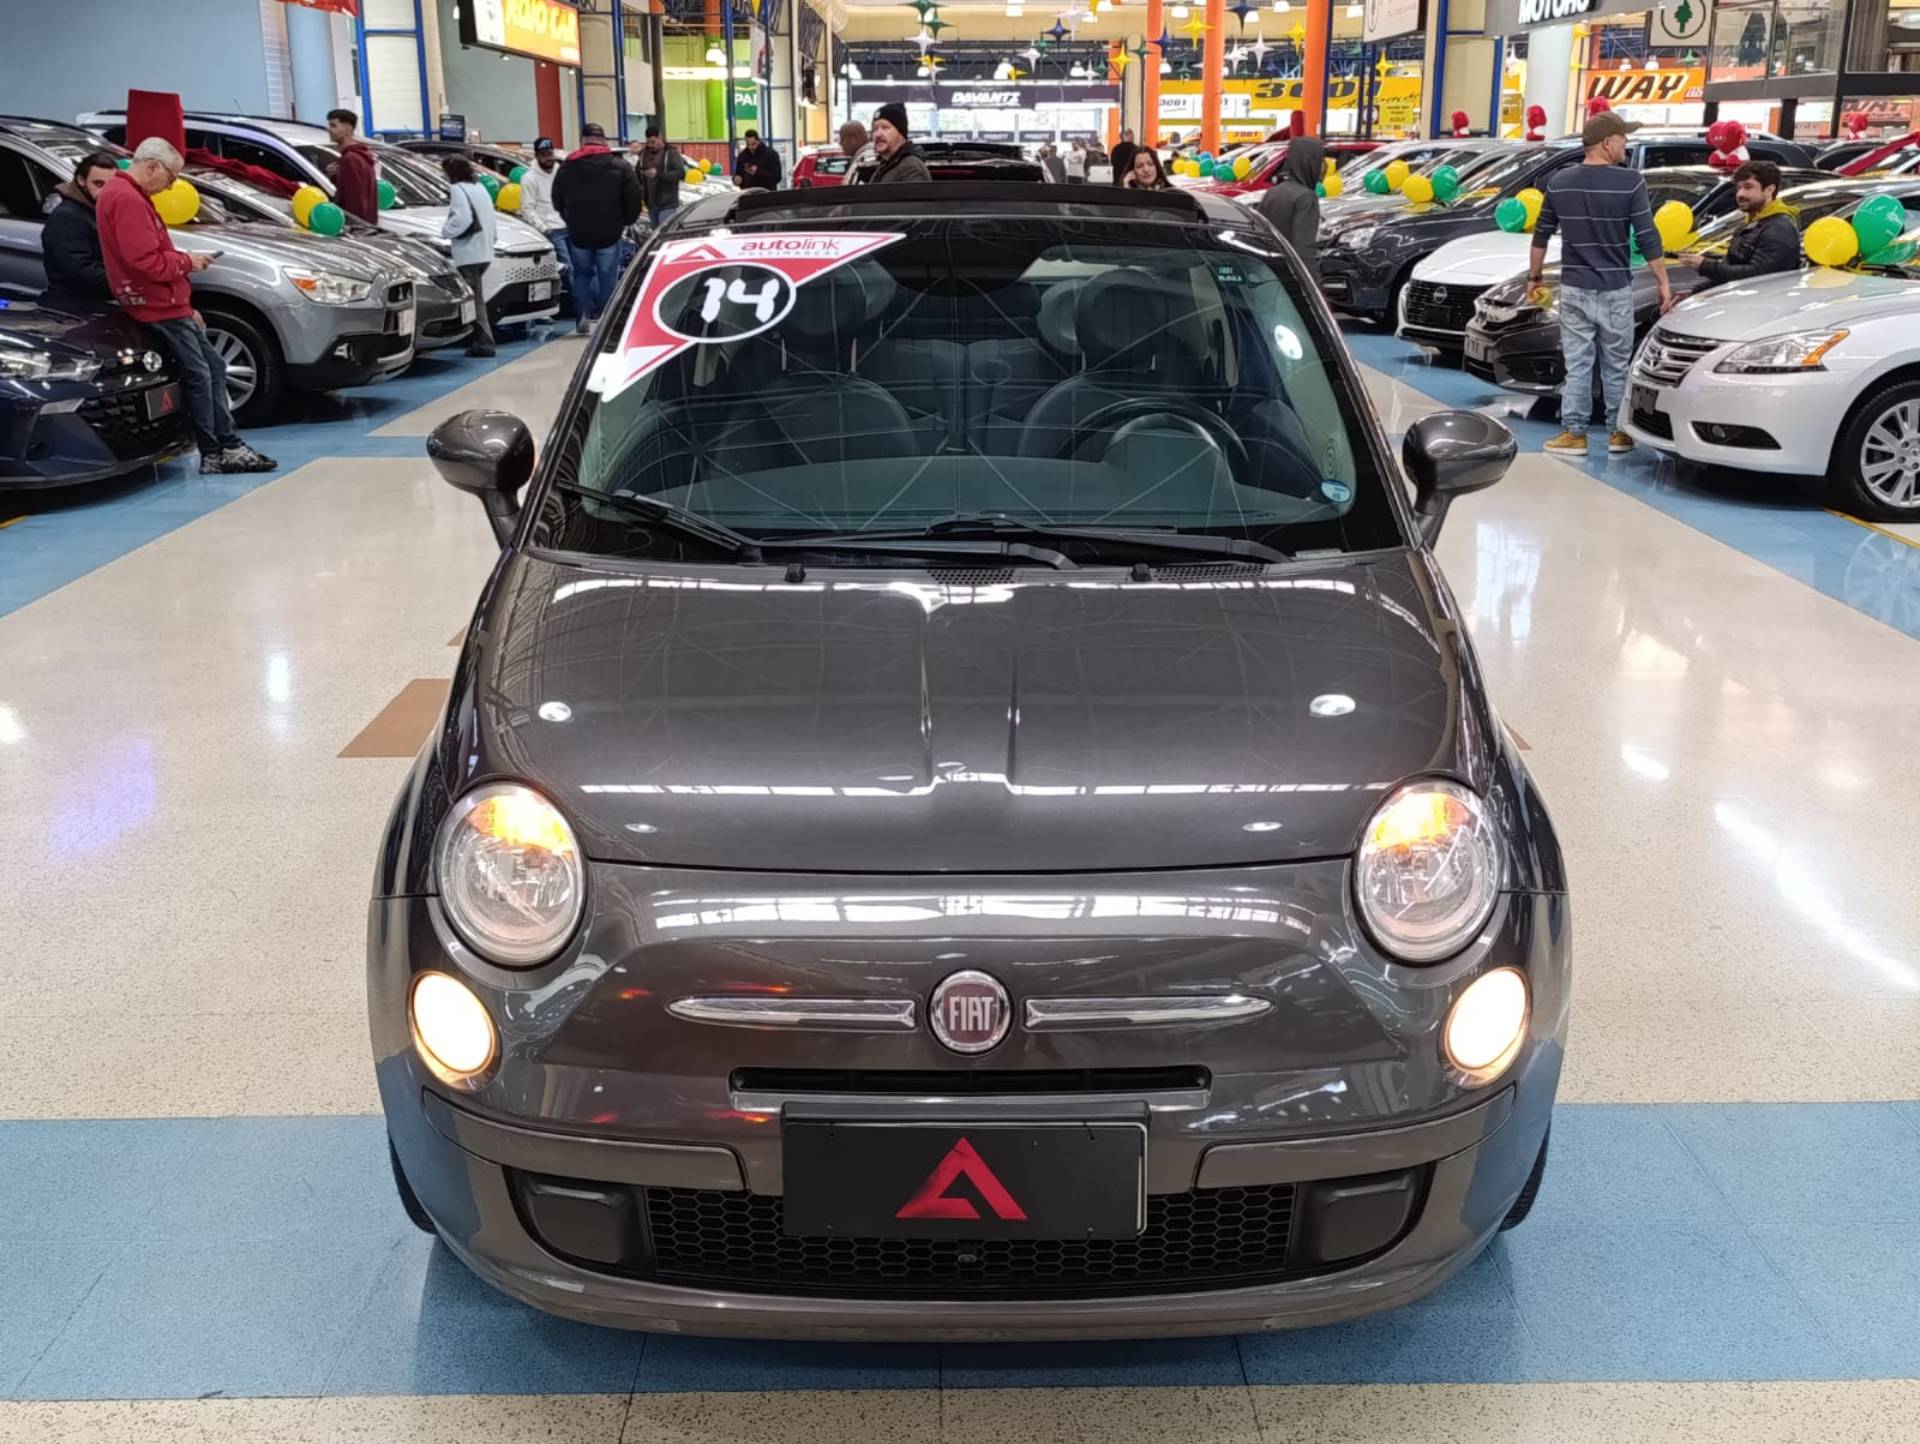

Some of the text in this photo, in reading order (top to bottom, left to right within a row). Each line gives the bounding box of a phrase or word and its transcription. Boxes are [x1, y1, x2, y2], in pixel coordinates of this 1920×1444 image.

[1588, 75, 1686, 100] WAY
[741, 239, 840, 251] autolink
[701, 278, 780, 323] 14
[949, 996, 995, 1031] FIAT
